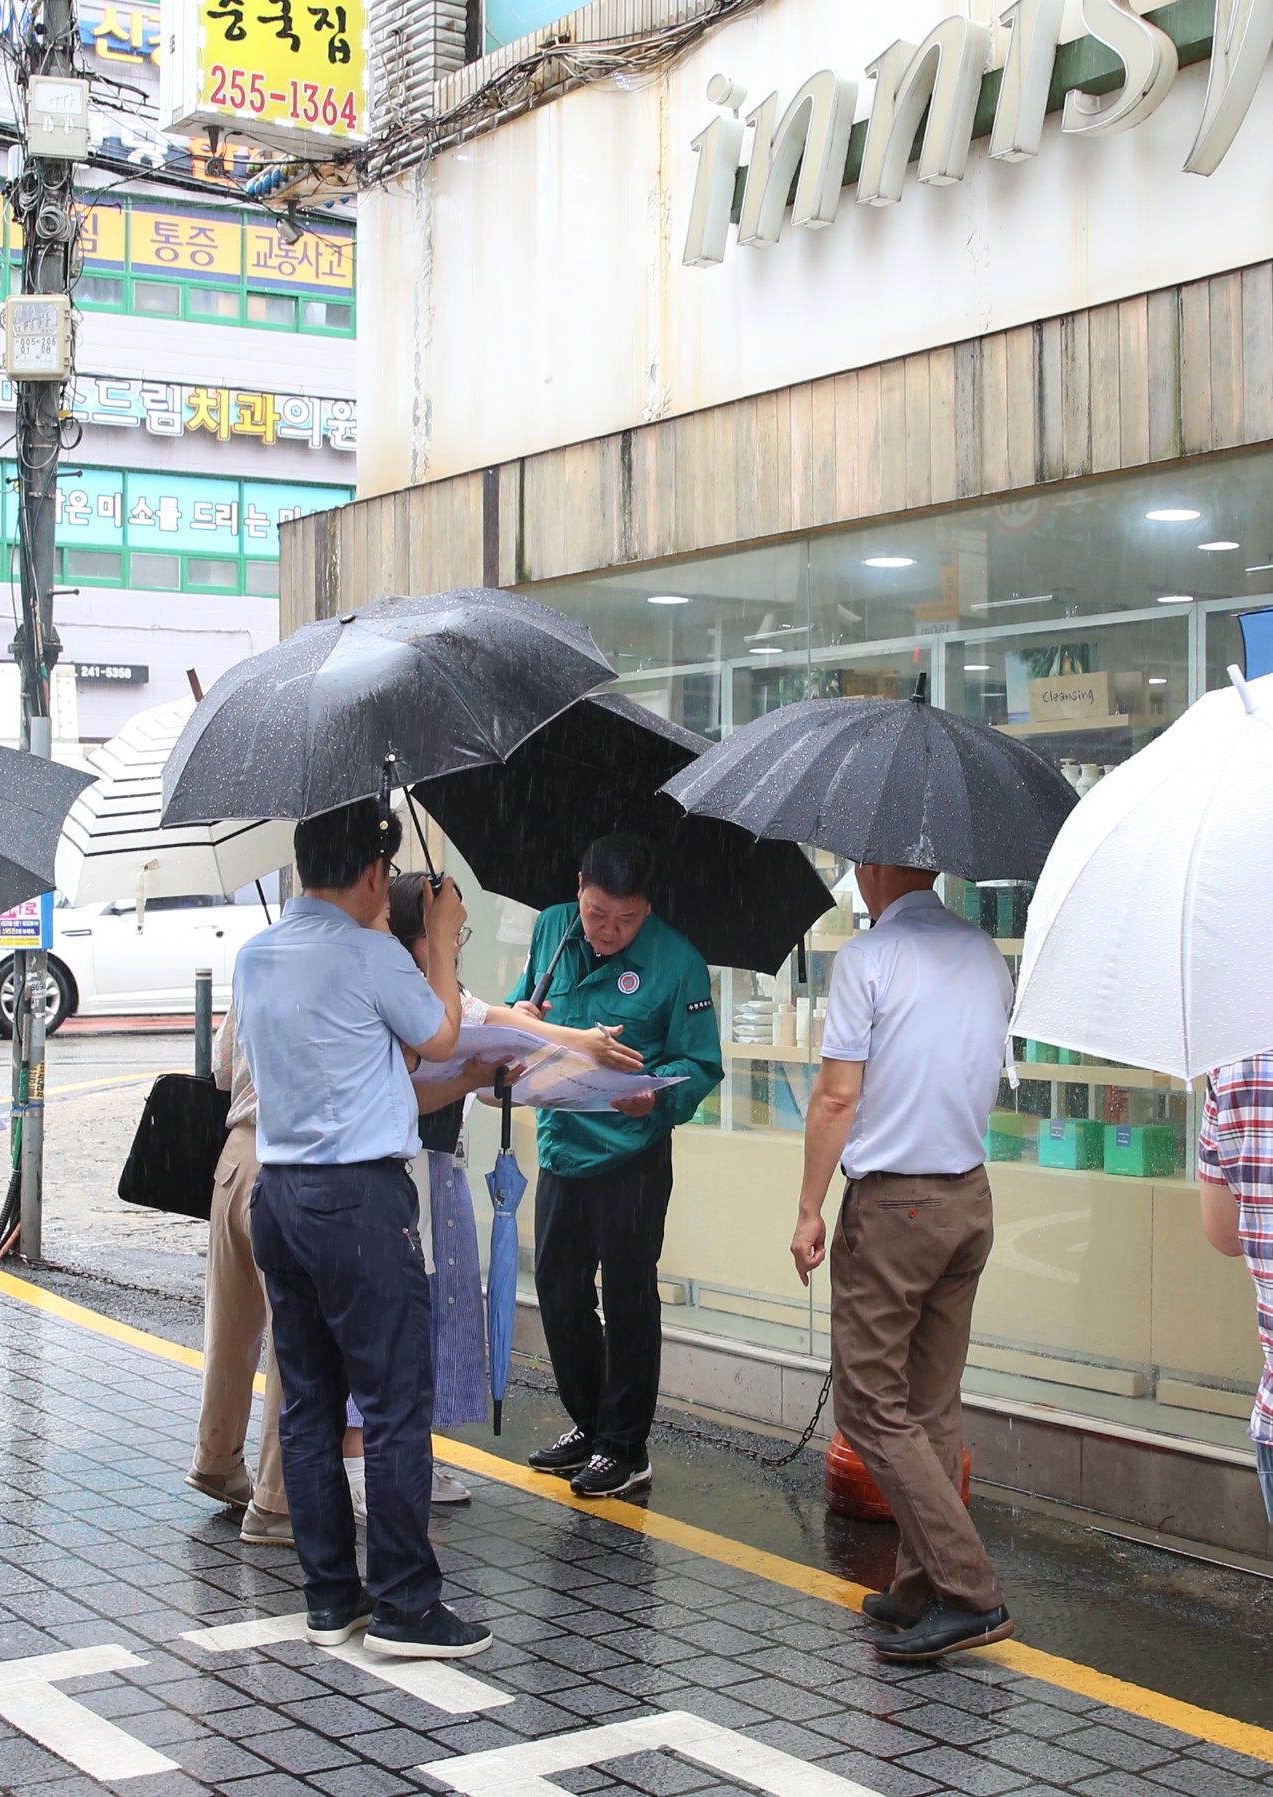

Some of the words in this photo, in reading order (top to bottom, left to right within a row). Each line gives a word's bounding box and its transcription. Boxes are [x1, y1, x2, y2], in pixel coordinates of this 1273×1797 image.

[211, 64, 357, 129] 255-1364
[149, 220, 219, 268] 통증
[251, 234, 347, 281] 교통사고
[97, 492, 183, 533] 미소를
[189, 501, 272, 539] 드리는
[1042, 689, 1094, 705] Cleansing
